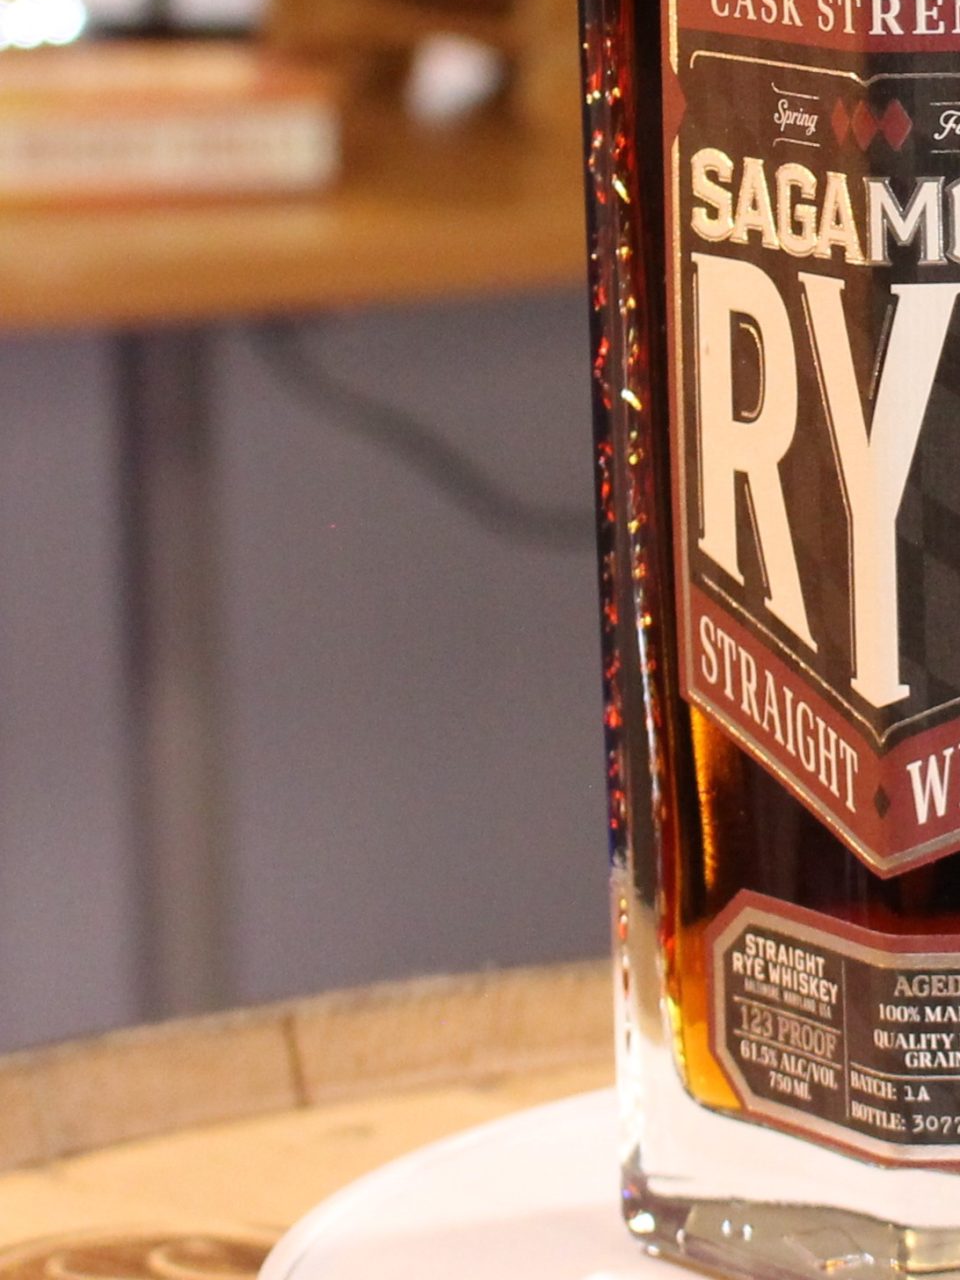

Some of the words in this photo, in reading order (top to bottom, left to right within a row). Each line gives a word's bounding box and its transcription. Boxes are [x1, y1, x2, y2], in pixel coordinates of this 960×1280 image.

[773, 98, 819, 137] Spring
[699, 615, 859, 814] STRAIGHT
[745, 933, 825, 978] STRAIGHT
[732, 951, 765, 981] RYE
[767, 962, 839, 1005] WHISKEY
[741, 1004, 773, 1037] 123
[777, 1015, 838, 1059] PROOF
[878, 1003, 921, 1022] 100%
[873, 1028, 954, 1050] QUALITY
[850, 1070, 897, 1100] BATCH:
[850, 1100, 906, 1131] BOTTLE:
